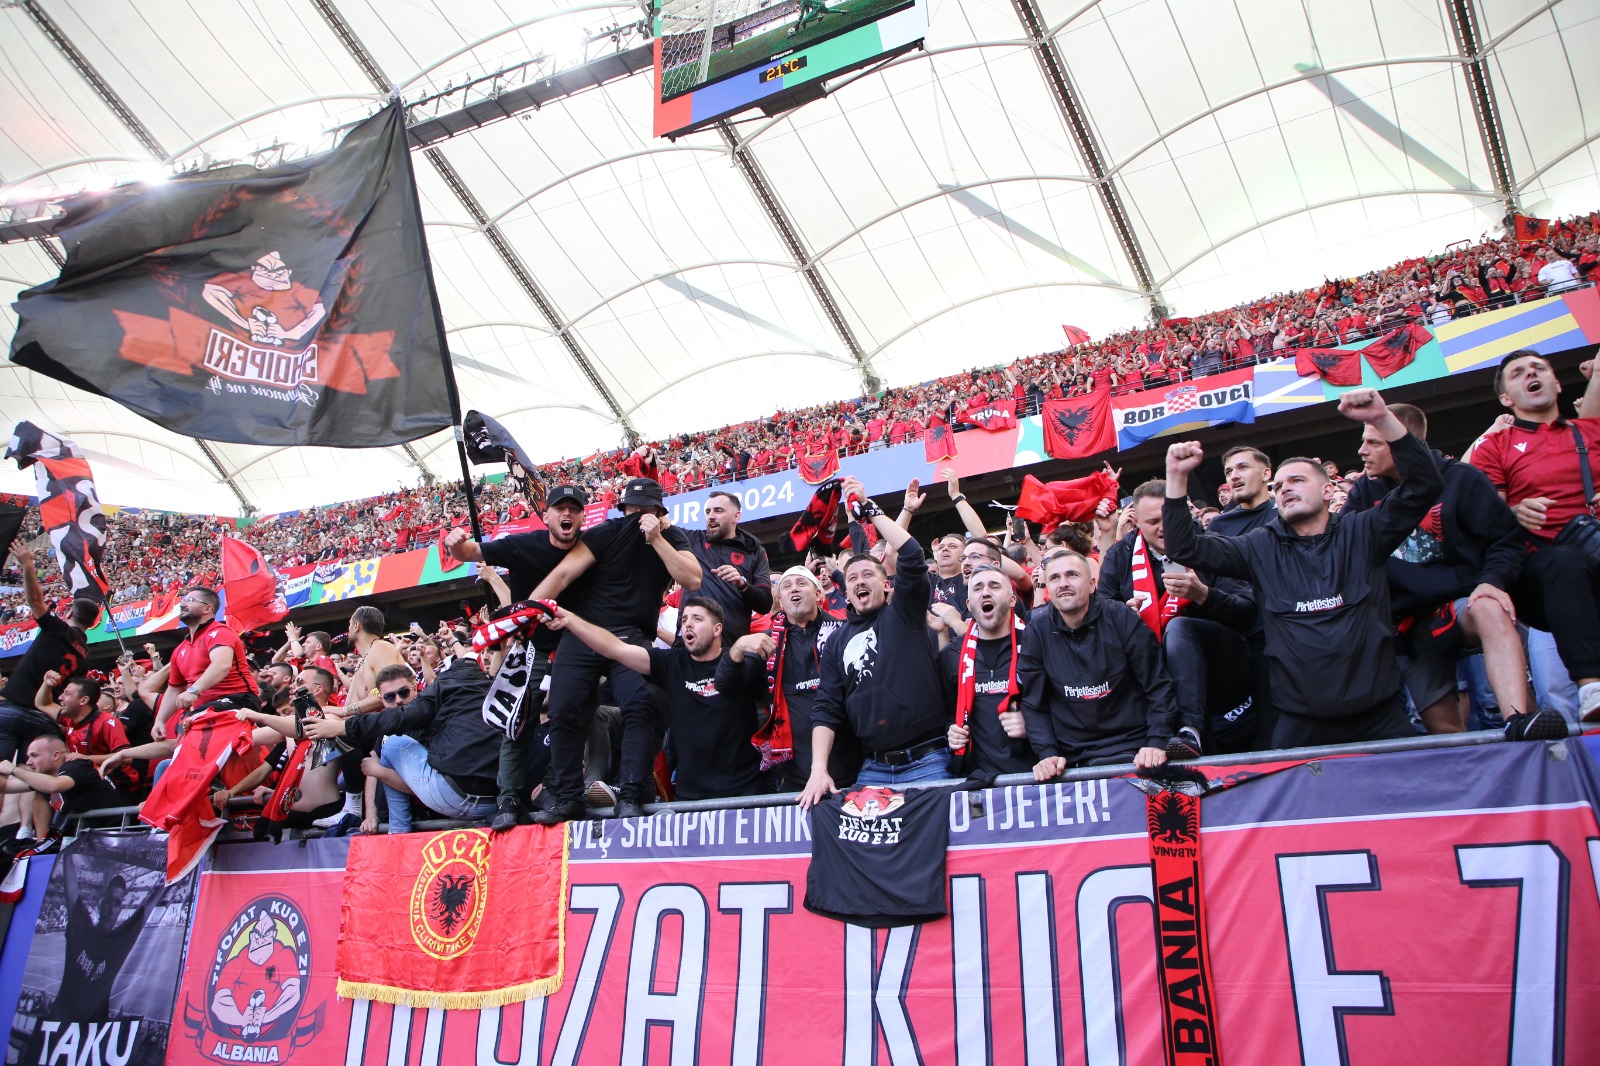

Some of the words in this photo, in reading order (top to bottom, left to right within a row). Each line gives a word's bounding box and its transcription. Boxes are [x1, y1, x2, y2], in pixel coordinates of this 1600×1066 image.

[766, 58, 799, 82] 21°C
[428, 833, 487, 866] UÇK
[871, 833, 882, 845] E
[1153, 846, 1197, 858] ALBANIA
[211, 906, 257, 986] TIFOZAT
[270, 900, 299, 929] KUQ
[296, 930, 307, 947] E
[1158, 876, 1214, 1066] BANIA
[38, 1019, 140, 1066] TAKU
[212, 1042, 279, 1063] ALBANIA
